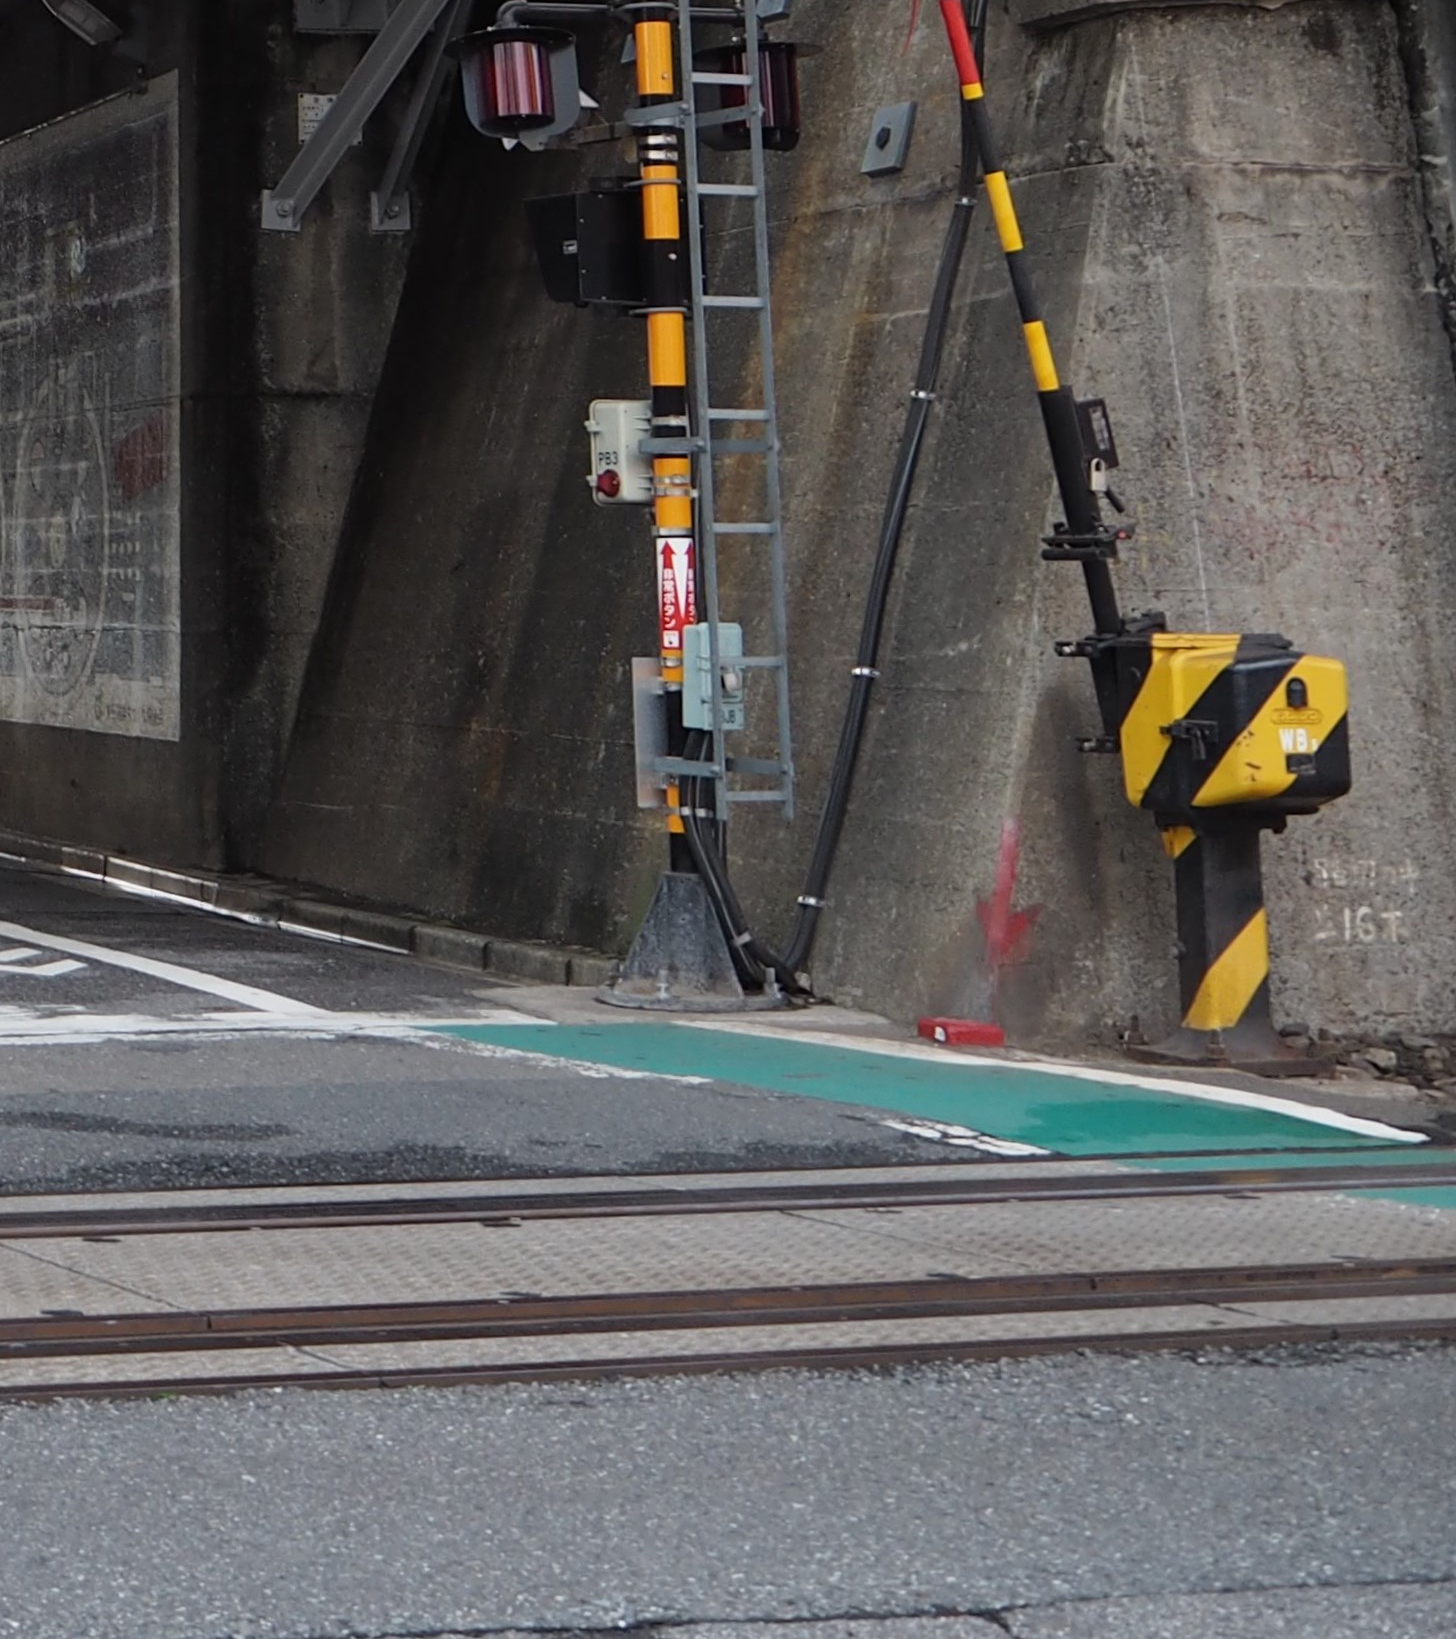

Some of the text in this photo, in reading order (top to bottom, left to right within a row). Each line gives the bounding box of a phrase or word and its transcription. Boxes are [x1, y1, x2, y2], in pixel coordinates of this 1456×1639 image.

[598, 451, 618, 465] PB3
[662, 568, 677, 629] 非常ボタン
